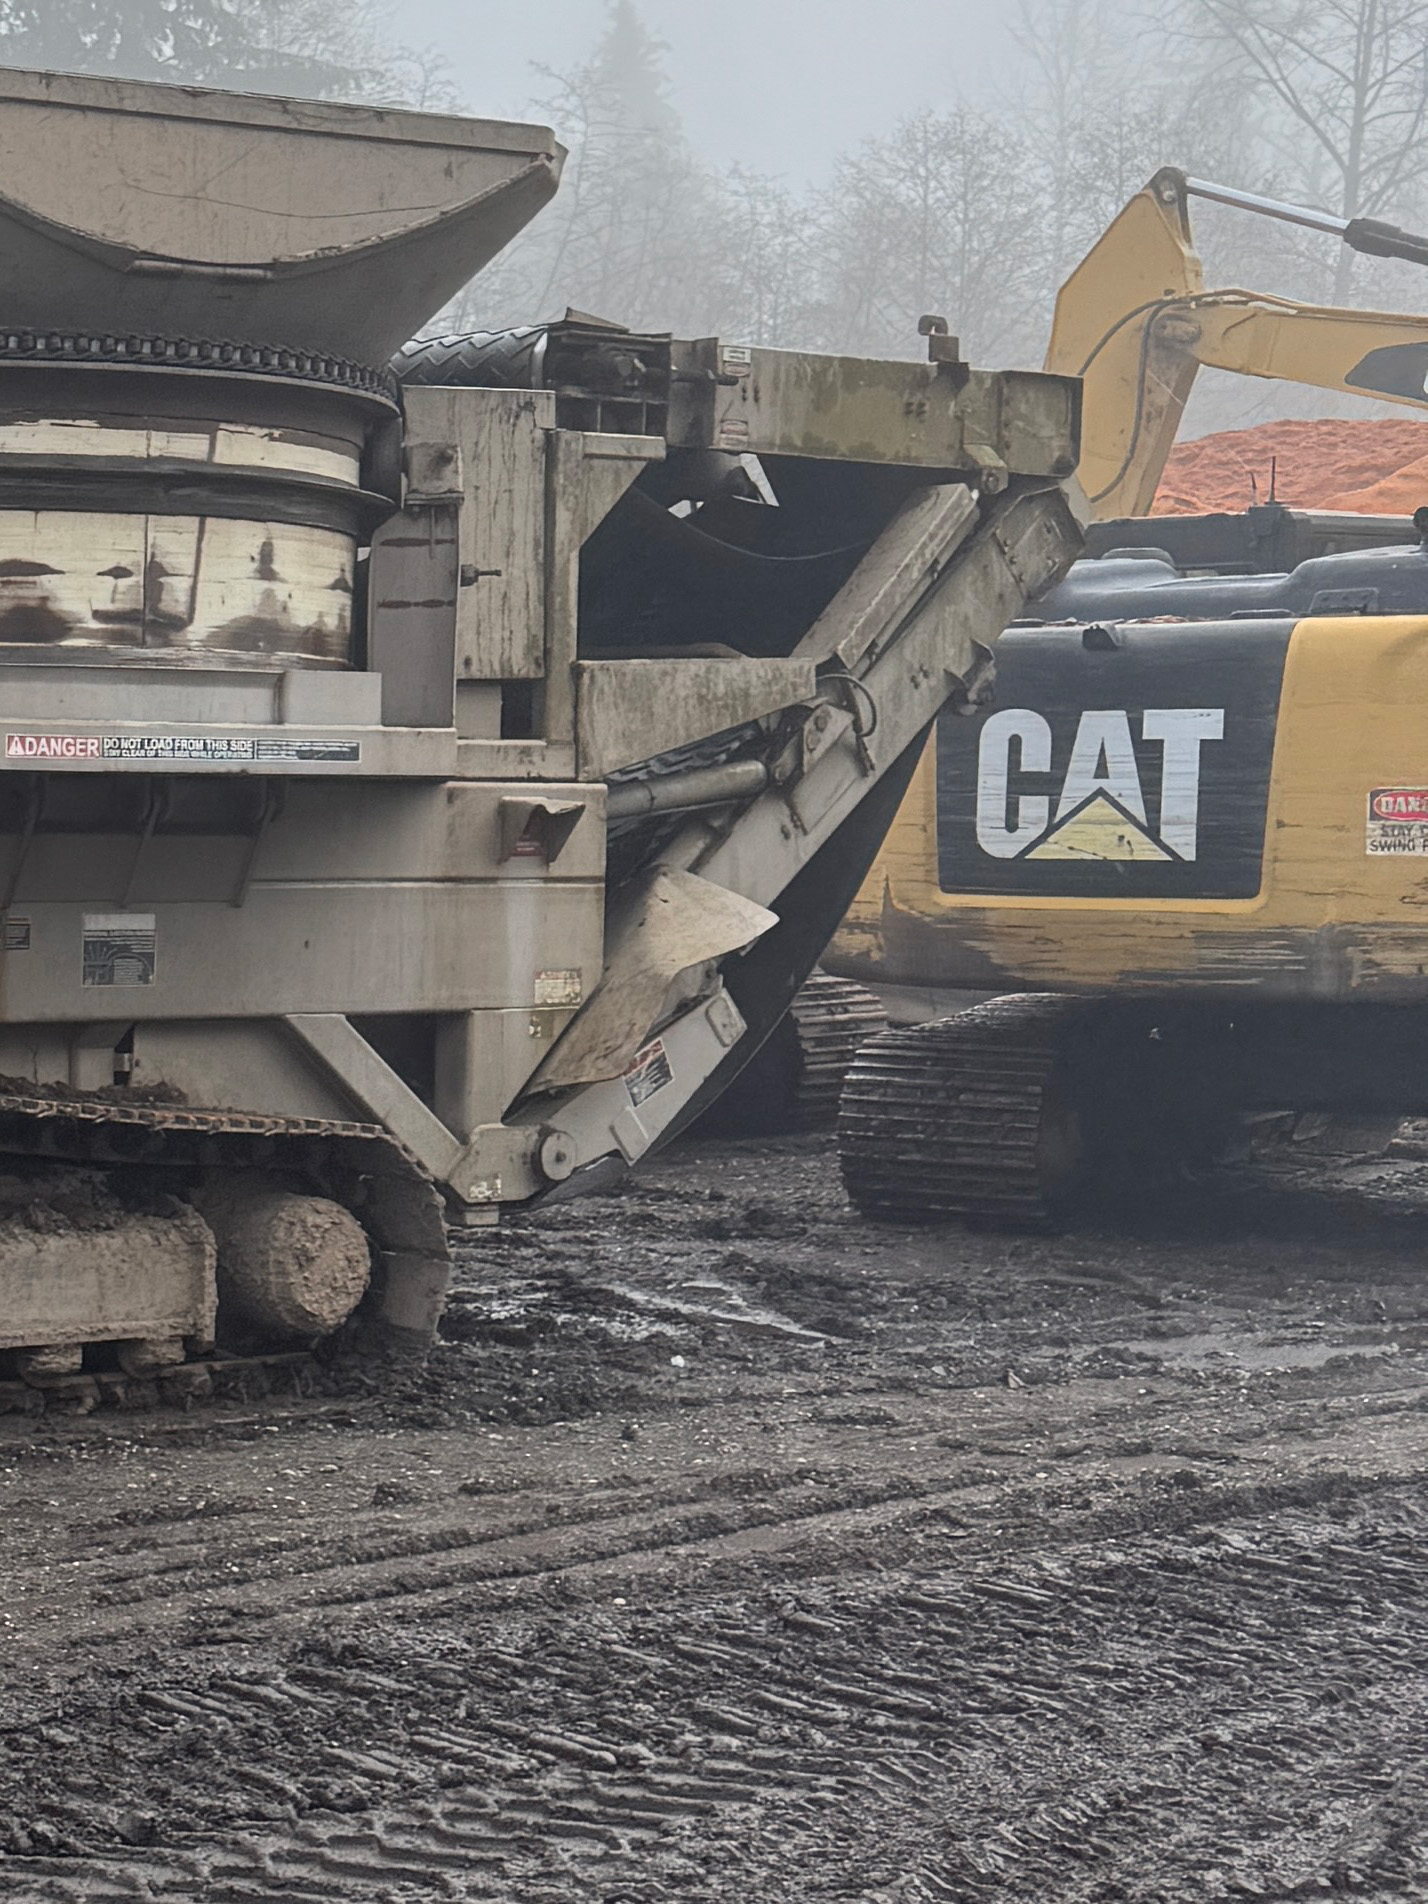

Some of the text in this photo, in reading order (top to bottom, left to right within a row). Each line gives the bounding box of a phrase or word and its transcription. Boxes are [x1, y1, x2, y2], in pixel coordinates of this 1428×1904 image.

[25, 737, 100, 757] DANGER
[104, 737, 119, 749] DO
[121, 738, 141, 750] NOT
[144, 739, 173, 750] LOAD
[175, 739, 204, 751] FROM
[205, 739, 228, 751] THIS
[230, 740, 253, 751] SIDE
[976, 708, 1225, 861] CAT
